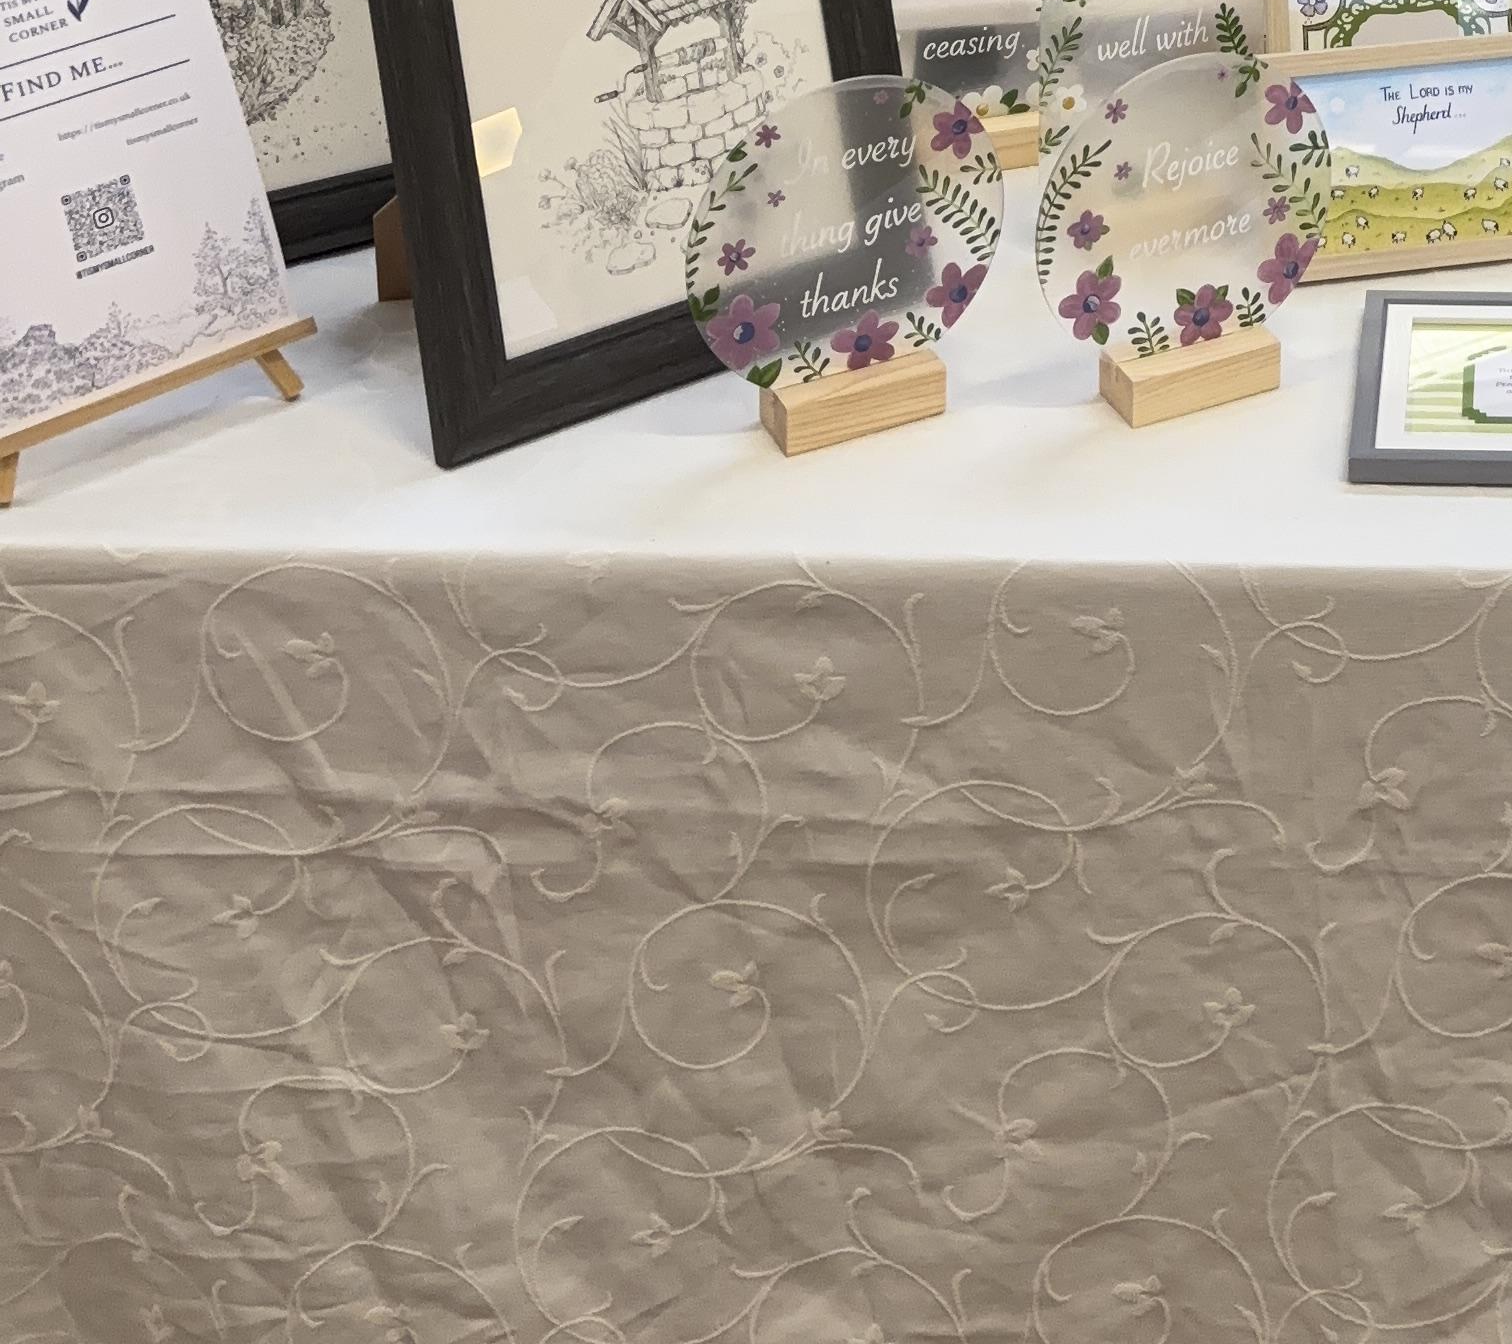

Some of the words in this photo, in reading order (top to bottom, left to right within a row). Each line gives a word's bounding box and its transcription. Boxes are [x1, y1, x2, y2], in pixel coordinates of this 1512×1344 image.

[3, 5, 54, 28] SMALL
[8, 17, 69, 43] CORNER
[1096, 14, 1151, 63] well
[1156, 8, 1209, 53] with
[0, 70, 62, 103] FIND
[840, 134, 917, 171] every
[1141, 140, 1240, 192] Rejoice
[863, 196, 923, 247] give
[1129, 212, 1252, 262] evermore
[799, 257, 900, 319] thanks
